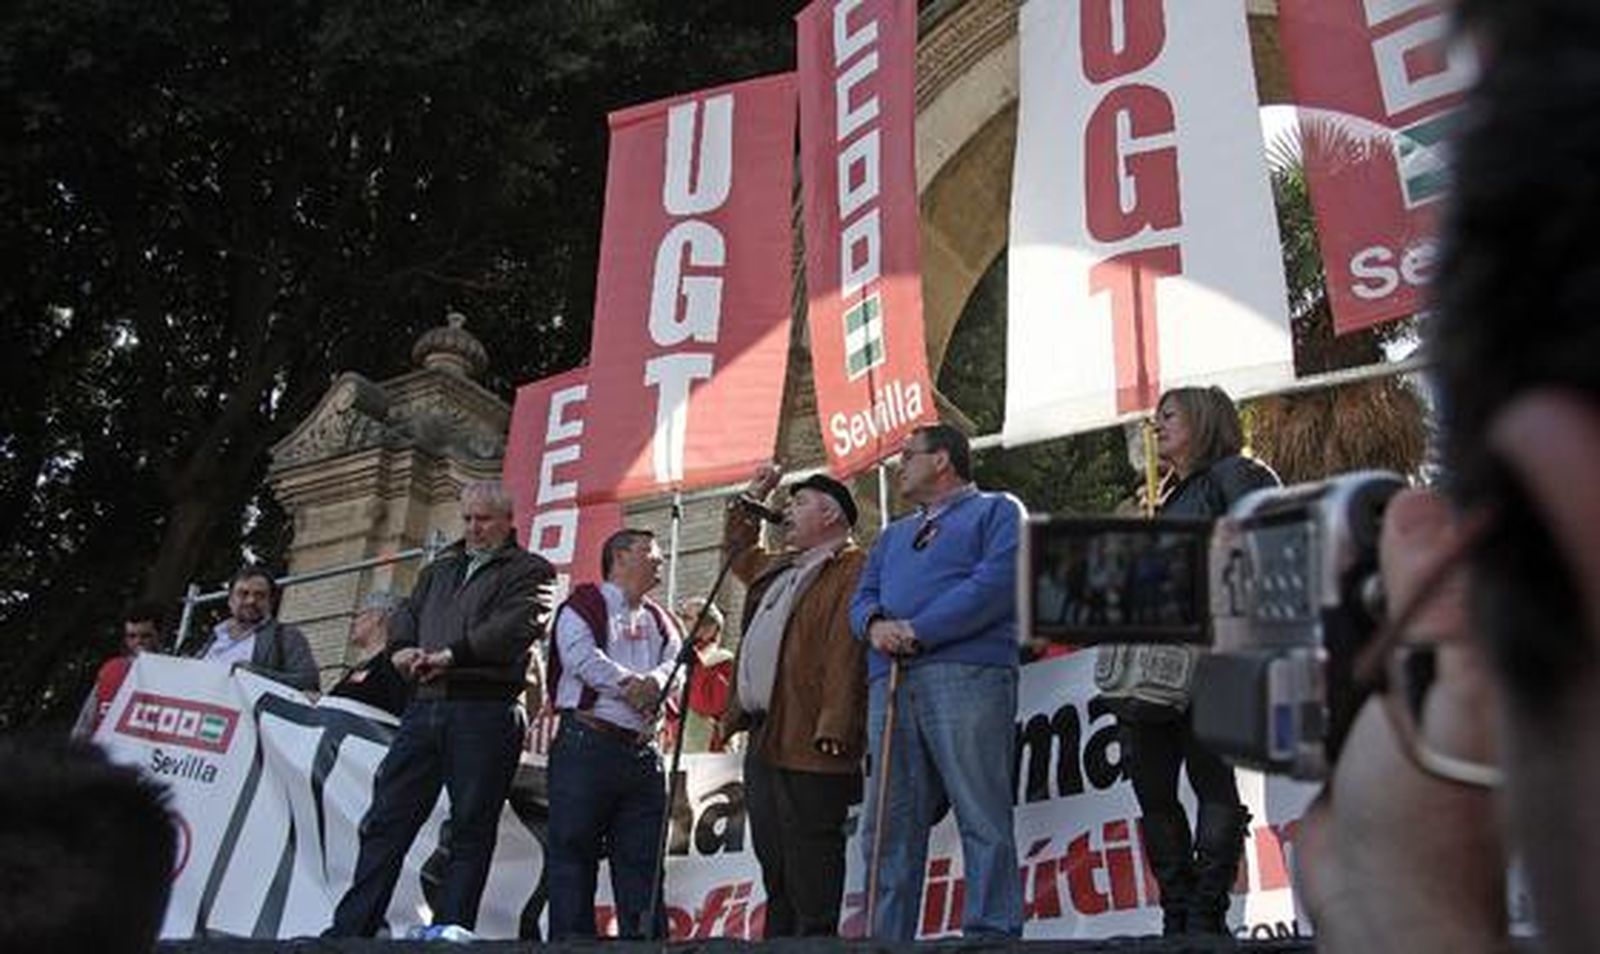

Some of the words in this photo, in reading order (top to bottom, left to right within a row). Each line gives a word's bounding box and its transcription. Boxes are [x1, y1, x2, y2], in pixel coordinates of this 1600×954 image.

[645, 93, 735, 483] UGT
[1078, 0, 1182, 416] UGT
[829, 380, 923, 457] Sevilla
[151, 750, 218, 783] Sevilla
